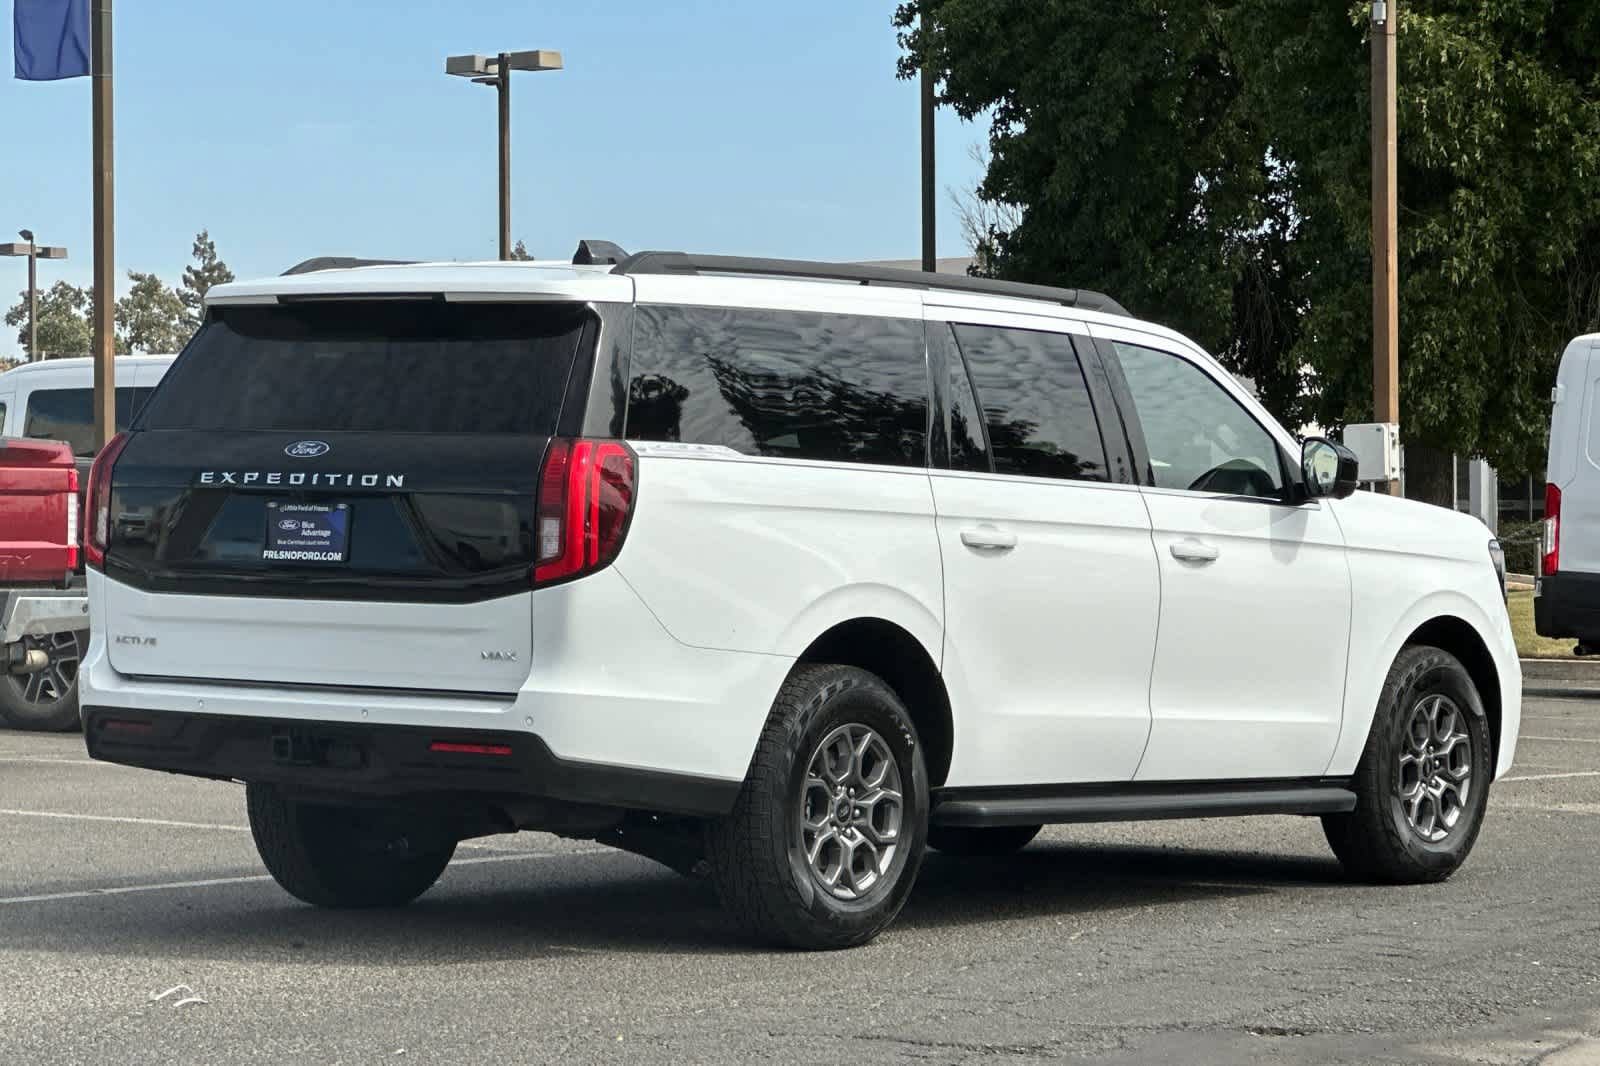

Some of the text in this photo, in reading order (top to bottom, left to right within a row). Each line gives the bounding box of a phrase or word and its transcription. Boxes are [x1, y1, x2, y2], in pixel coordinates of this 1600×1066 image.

[289, 443, 323, 455] Ford
[200, 472, 404, 487] EXPEDITION
[301, 529, 331, 537] Advantage
[263, 550, 342, 560] FRESNOFORD.COM
[480, 650, 517, 662] MAX
